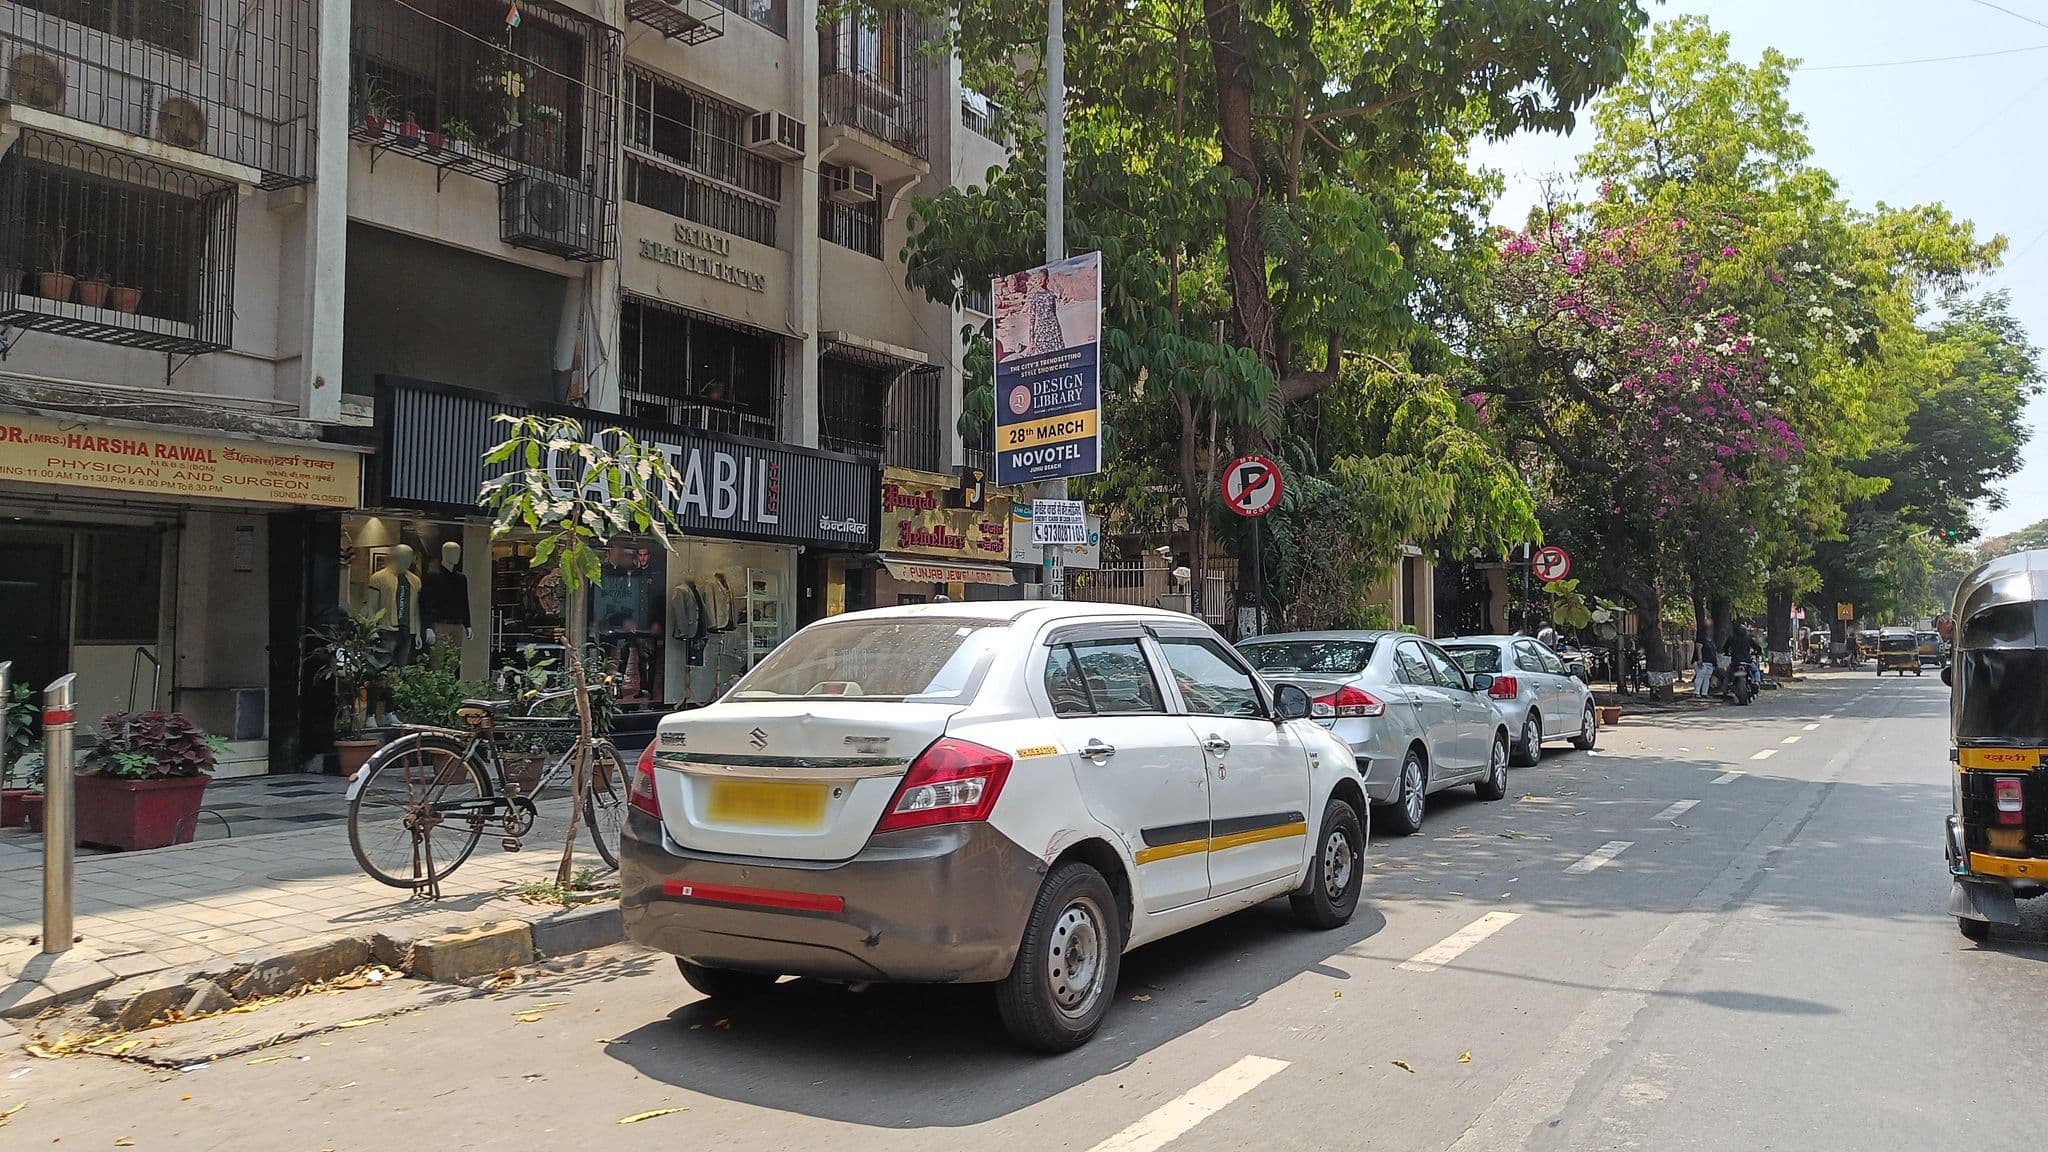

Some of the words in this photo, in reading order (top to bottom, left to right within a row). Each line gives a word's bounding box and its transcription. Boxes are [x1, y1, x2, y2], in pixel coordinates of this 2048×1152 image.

[1010, 365, 1020, 373] THE
[1020, 368, 1037, 378] STYLE
[1038, 362, 1070, 375] SHOWCASE
[1033, 373, 1083, 396] DESIGN
[1033, 387, 1083, 409] LIBRARY
[1009, 428, 1034, 444] 28th
[1036, 419, 1084, 440] MARCH
[68, 433, 149, 458] HARSHA
[155, 443, 217, 464] RAWAL
[1012, 443, 1081, 468] NOVOTEL
[47, 458, 160, 477] PHYSICIAN
[173, 471, 214, 482] AND
[222, 475, 310, 490] SURGEON
[1044, 463, 1062, 471] BEACH
[910, 566, 943, 580] PUNJAB
